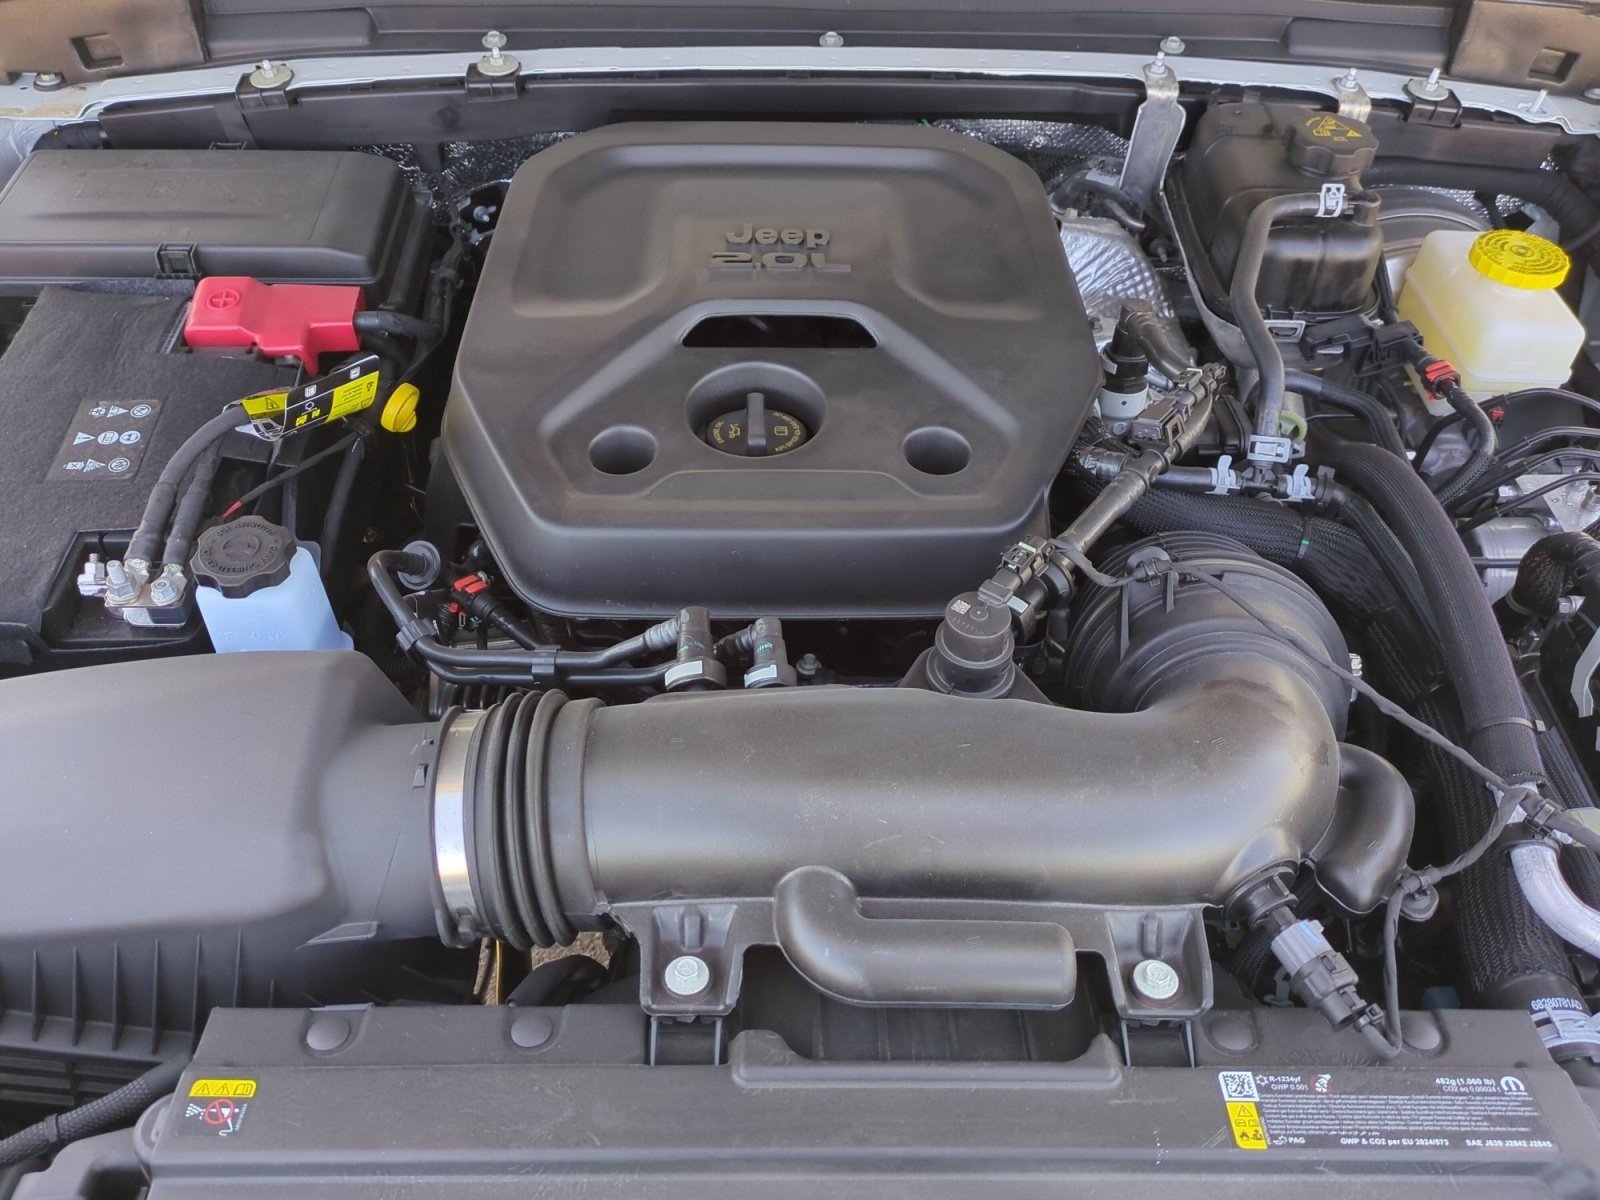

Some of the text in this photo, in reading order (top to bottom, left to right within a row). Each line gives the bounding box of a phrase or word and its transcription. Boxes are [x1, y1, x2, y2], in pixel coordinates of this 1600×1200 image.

[726, 223, 830, 250] Jeep
[709, 252, 851, 273] 2.0L
[1269, 1075, 1301, 1084] R-1234yf
[1435, 1077, 1456, 1086] 482g
[1483, 1077, 1496, 1087] lb)
[1271, 1083, 1288, 1091] GWP
[1288, 1137, 1306, 1145] PAG
[1340, 1137, 1360, 1145] GWP
[1361, 1137, 1369, 1145] &
[1369, 1137, 1387, 1145] CO2
[1387, 1139, 1400, 1147] per
[1401, 1138, 1414, 1146] EU
[1465, 1139, 1483, 1147] SAE
